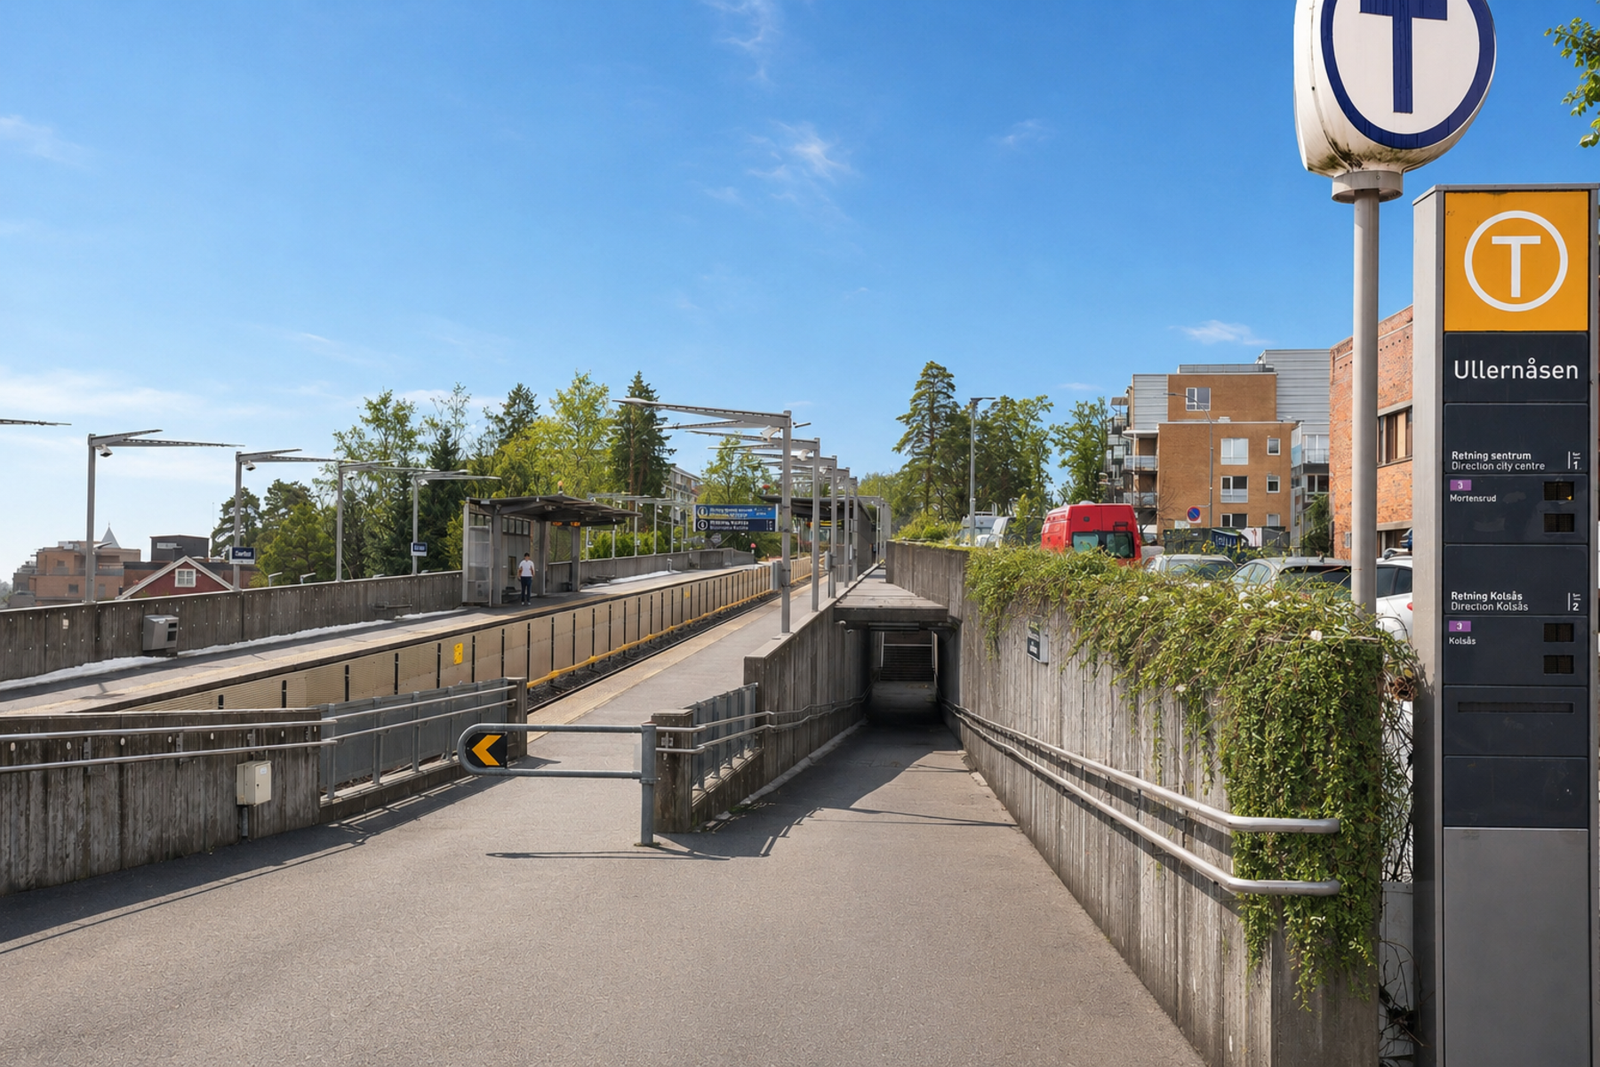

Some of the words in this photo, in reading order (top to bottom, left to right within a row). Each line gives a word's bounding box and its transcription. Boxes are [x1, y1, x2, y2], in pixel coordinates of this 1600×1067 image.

[1360, 0, 1447, 114] T
[1491, 235, 1541, 298] T
[1454, 357, 1579, 379] Ullernåsen
[1451, 451, 1489, 461] Retning
[1490, 452, 1532, 460] sentrum
[1451, 462, 1494, 471] Direction
[1496, 462, 1512, 472] city
[1514, 462, 1546, 471] centre
[1449, 494, 1497, 503] Mortensrud
[1451, 592, 1488, 602] Retning
[1490, 591, 1523, 601] Kolsås
[1451, 602, 1494, 611] Direction
[1496, 602, 1529, 611] Kolsås
[1572, 603, 1580, 612] 2
[1448, 636, 1477, 645] Kolsås
